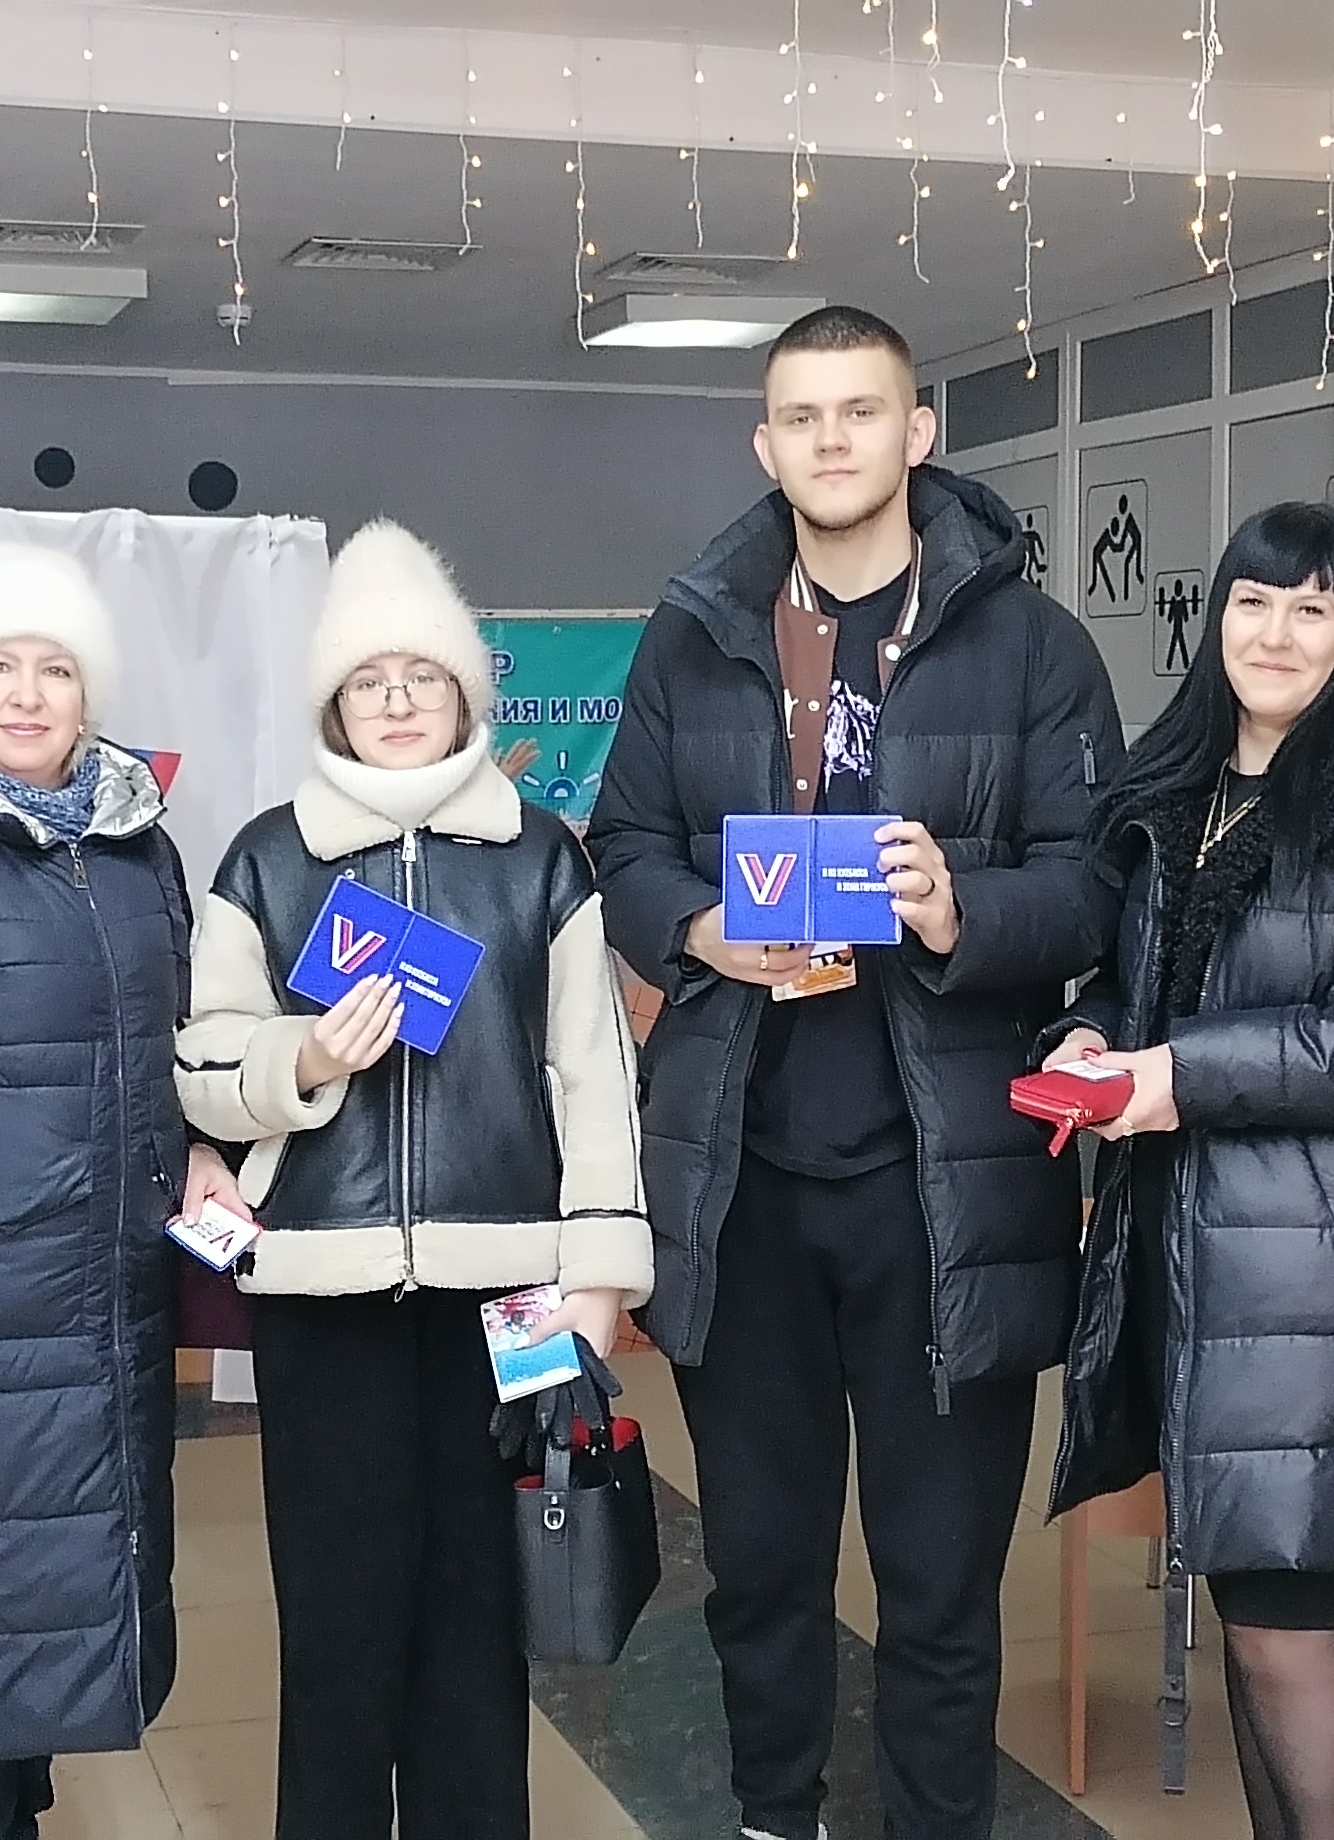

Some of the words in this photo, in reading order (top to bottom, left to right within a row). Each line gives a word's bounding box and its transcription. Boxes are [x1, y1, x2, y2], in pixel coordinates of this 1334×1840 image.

[490, 650, 514, 686] Р
[491, 697, 541, 724] ИЯ
[549, 697, 570, 724] И
[578, 696, 622, 724] МО
